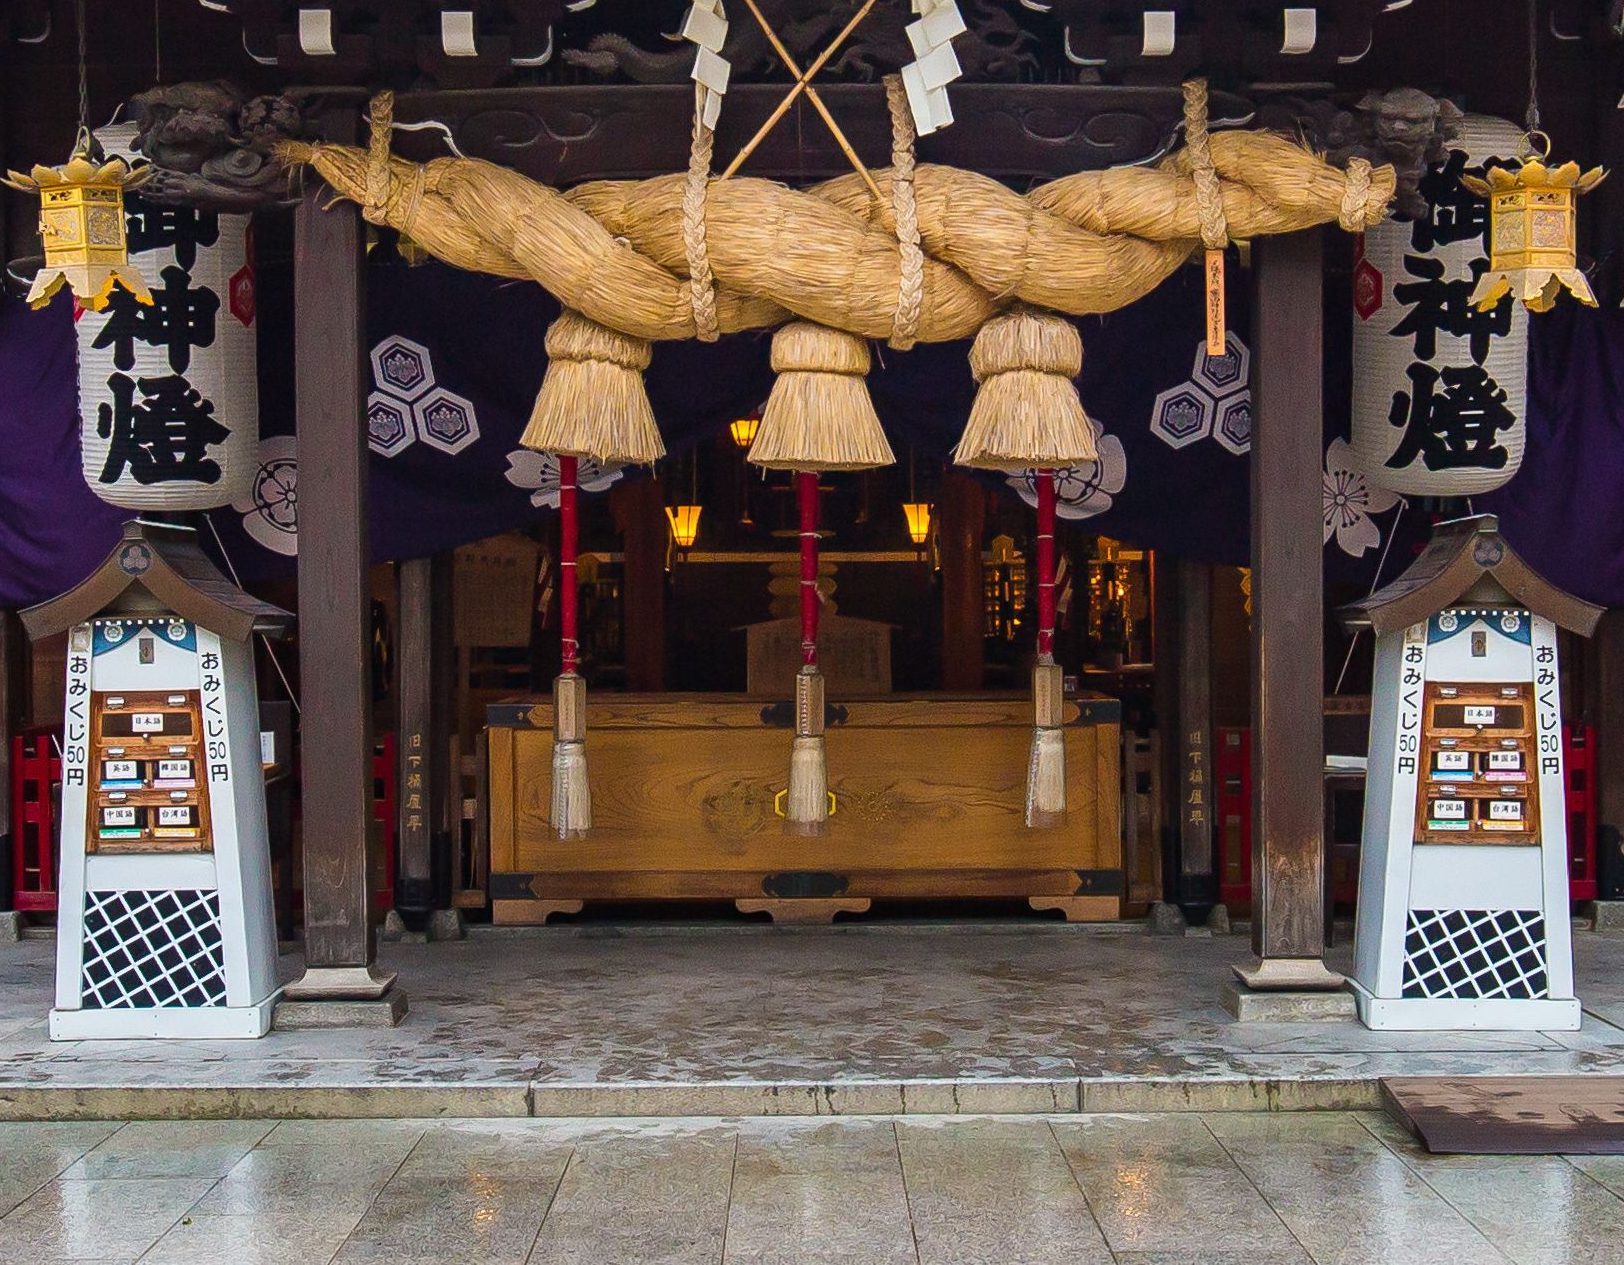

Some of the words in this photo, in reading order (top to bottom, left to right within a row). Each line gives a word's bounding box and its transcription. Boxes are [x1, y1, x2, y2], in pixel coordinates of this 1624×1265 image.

[67, 655, 88, 786] おみくじ50円
[135, 716, 161, 726] 日本語
[201, 651, 229, 783] おみくじ50円
[1398, 644, 1423, 775] おみくじ50円
[1467, 709, 1493, 718] 日本語
[1536, 644, 1560, 775] おみくじ50円
[106, 810, 133, 819] 中国語
[1436, 803, 1463, 812] 中国語
